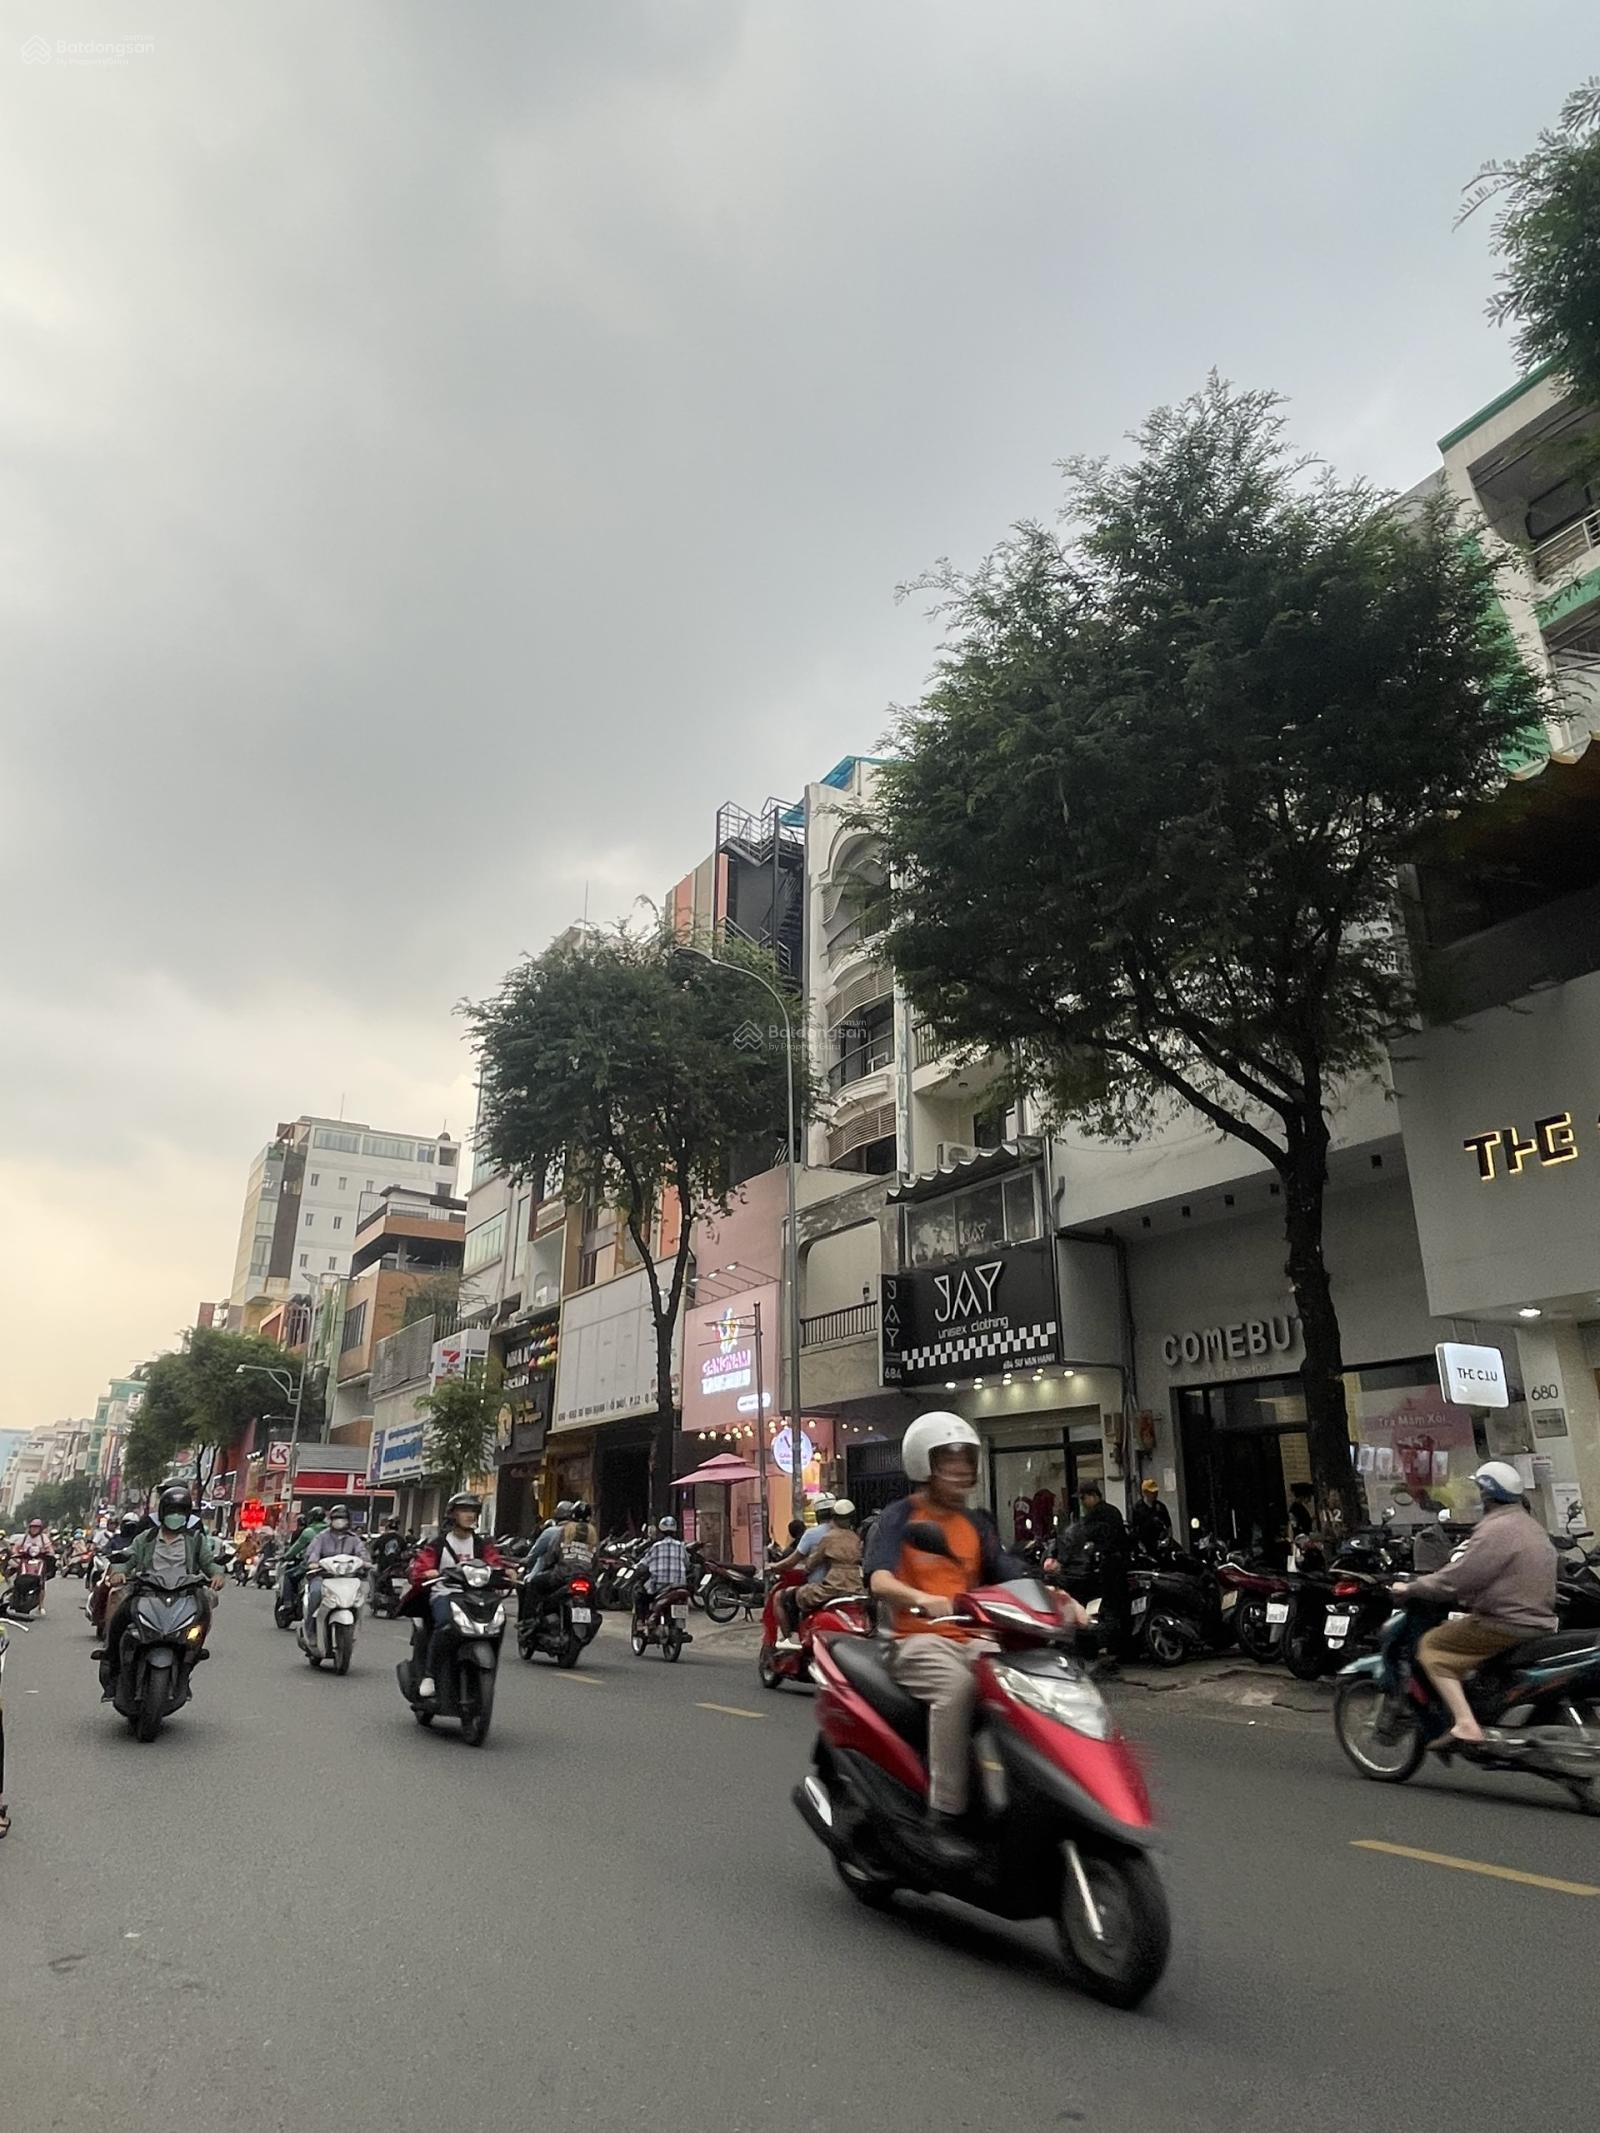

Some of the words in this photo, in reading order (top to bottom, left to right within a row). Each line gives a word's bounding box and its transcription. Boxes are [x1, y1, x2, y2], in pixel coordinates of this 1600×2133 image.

[1463, 1112, 1578, 1180] THE
[884, 1279, 901, 1348] JAY
[934, 1261, 1003, 1322] JAY
[938, 1325, 968, 1339] unisex
[971, 1316, 1009, 1334] clothing
[1531, 1384, 1559, 1401] 680
